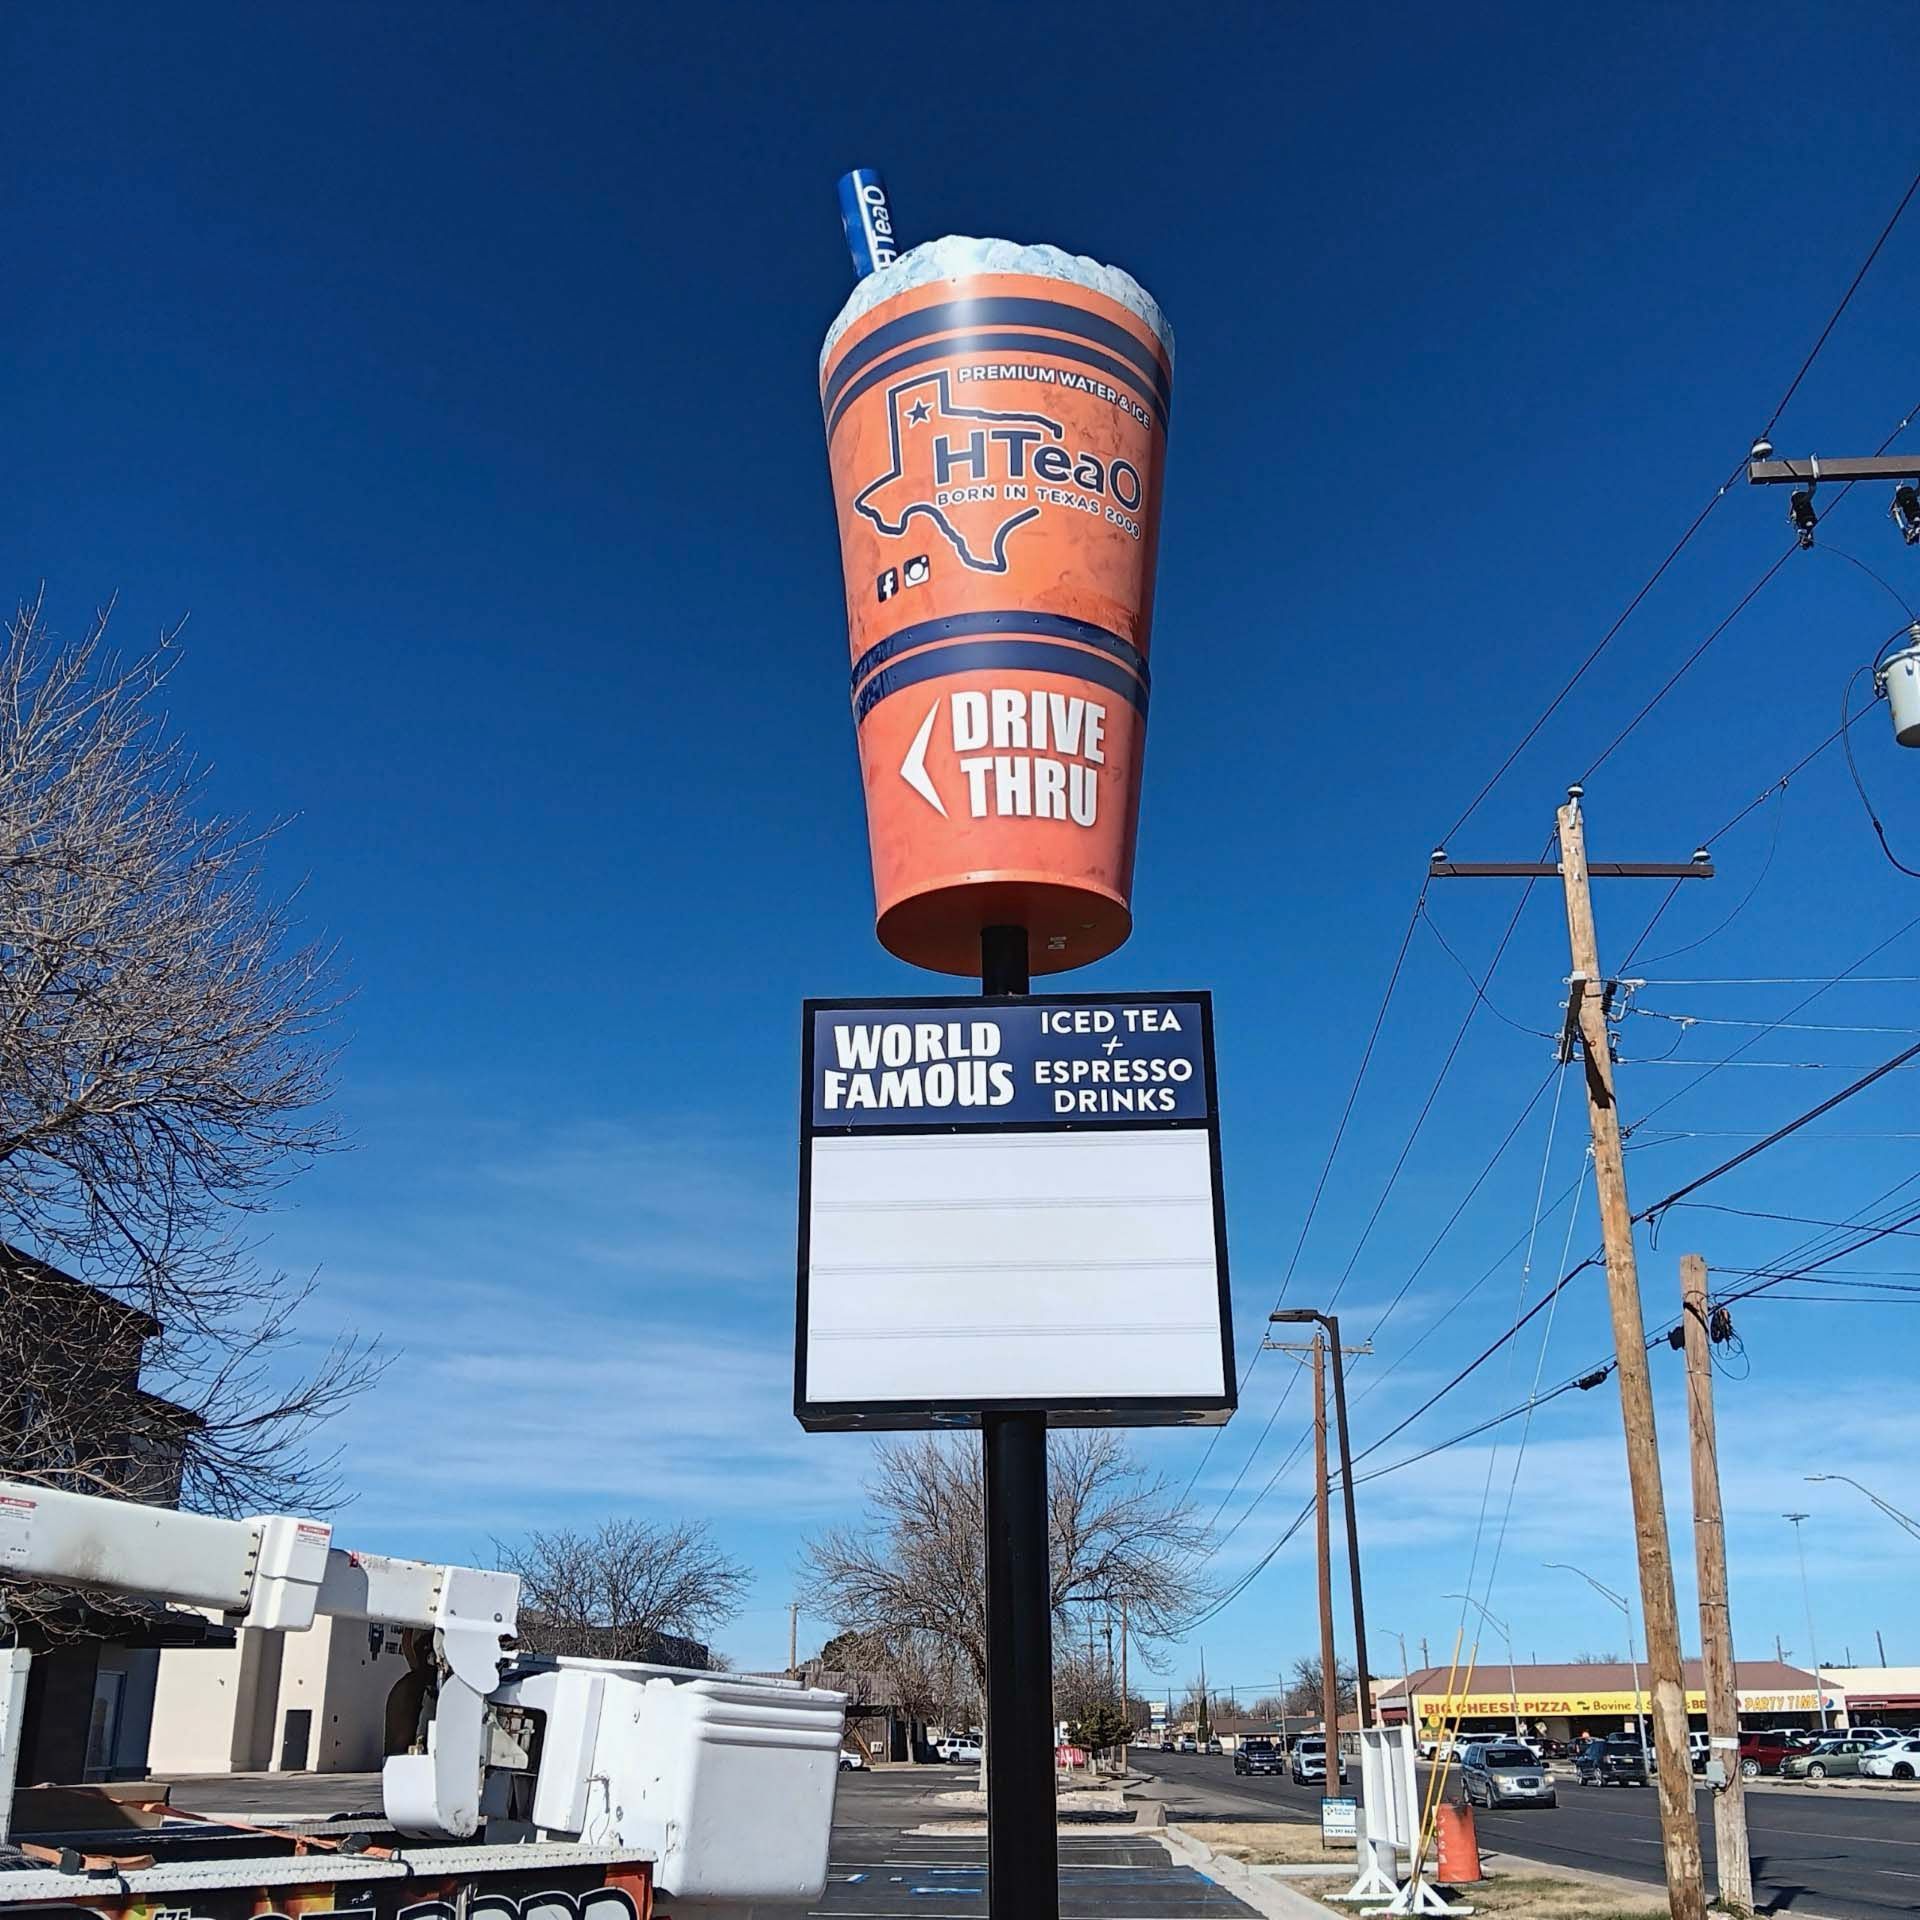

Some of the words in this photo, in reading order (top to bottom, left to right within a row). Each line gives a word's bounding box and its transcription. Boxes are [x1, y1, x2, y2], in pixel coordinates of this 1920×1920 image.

[957, 364, 1056, 384] PREMIUM
[1058, 372, 1118, 406] WATER
[1118, 395, 1131, 412] &
[1131, 401, 1151, 430] ICE
[934, 428, 1143, 513] HTeaO
[937, 486, 996, 507] BORN
[1005, 486, 1027, 500] IN
[1037, 488, 1100, 514] TEXAS
[1105, 507, 1141, 539] 2009
[951, 689, 1106, 765] DRIVE
[960, 756, 1098, 826] THRU
[1041, 1010, 1115, 1034] ICED
[1123, 1009, 1182, 1032] TEA
[834, 1022, 1001, 1070] WORLD
[824, 1061, 1015, 1110] FAMOUS
[1034, 1058, 1193, 1084] ESPRESSO
[1054, 1088, 1176, 1113] DRINKS
[1424, 1703, 1451, 1714] BIG
[1456, 1701, 1520, 1714] CHEESE
[1524, 1701, 1571, 1713] PIZZA
[1593, 1700, 1631, 1711] Bovine
[1744, 1697, 1785, 1712] PARTY
[1787, 1695, 1819, 1710] TIME
